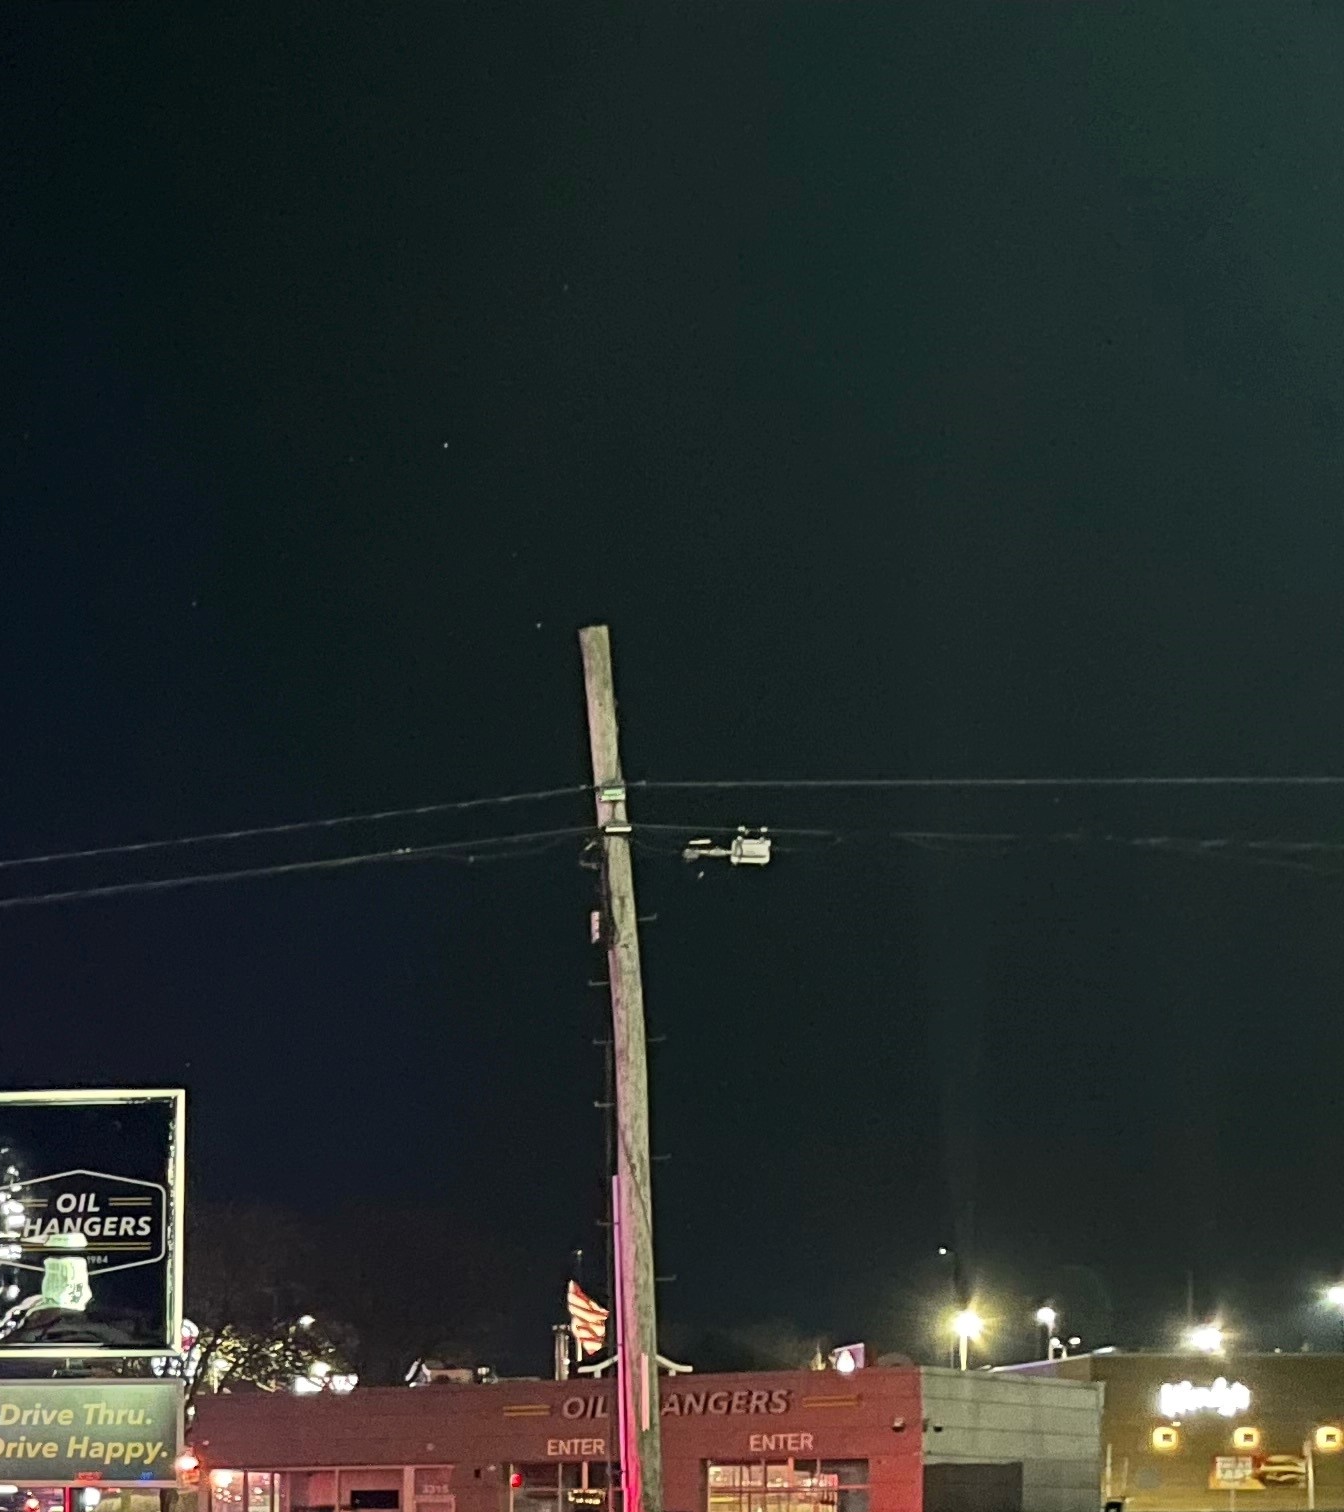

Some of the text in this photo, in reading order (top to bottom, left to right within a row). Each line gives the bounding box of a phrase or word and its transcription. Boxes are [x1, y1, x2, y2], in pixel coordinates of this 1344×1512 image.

[56, 1192, 100, 1213] OIL
[22, 1216, 152, 1238] HANGERS
[83, 1403, 153, 1425] Thru.
[562, 1388, 791, 1419] OIL ANGERS
[66, 1436, 168, 1465] Happy.
[547, 1438, 605, 1456] ENTER
[749, 1432, 813, 1452] ENTER
